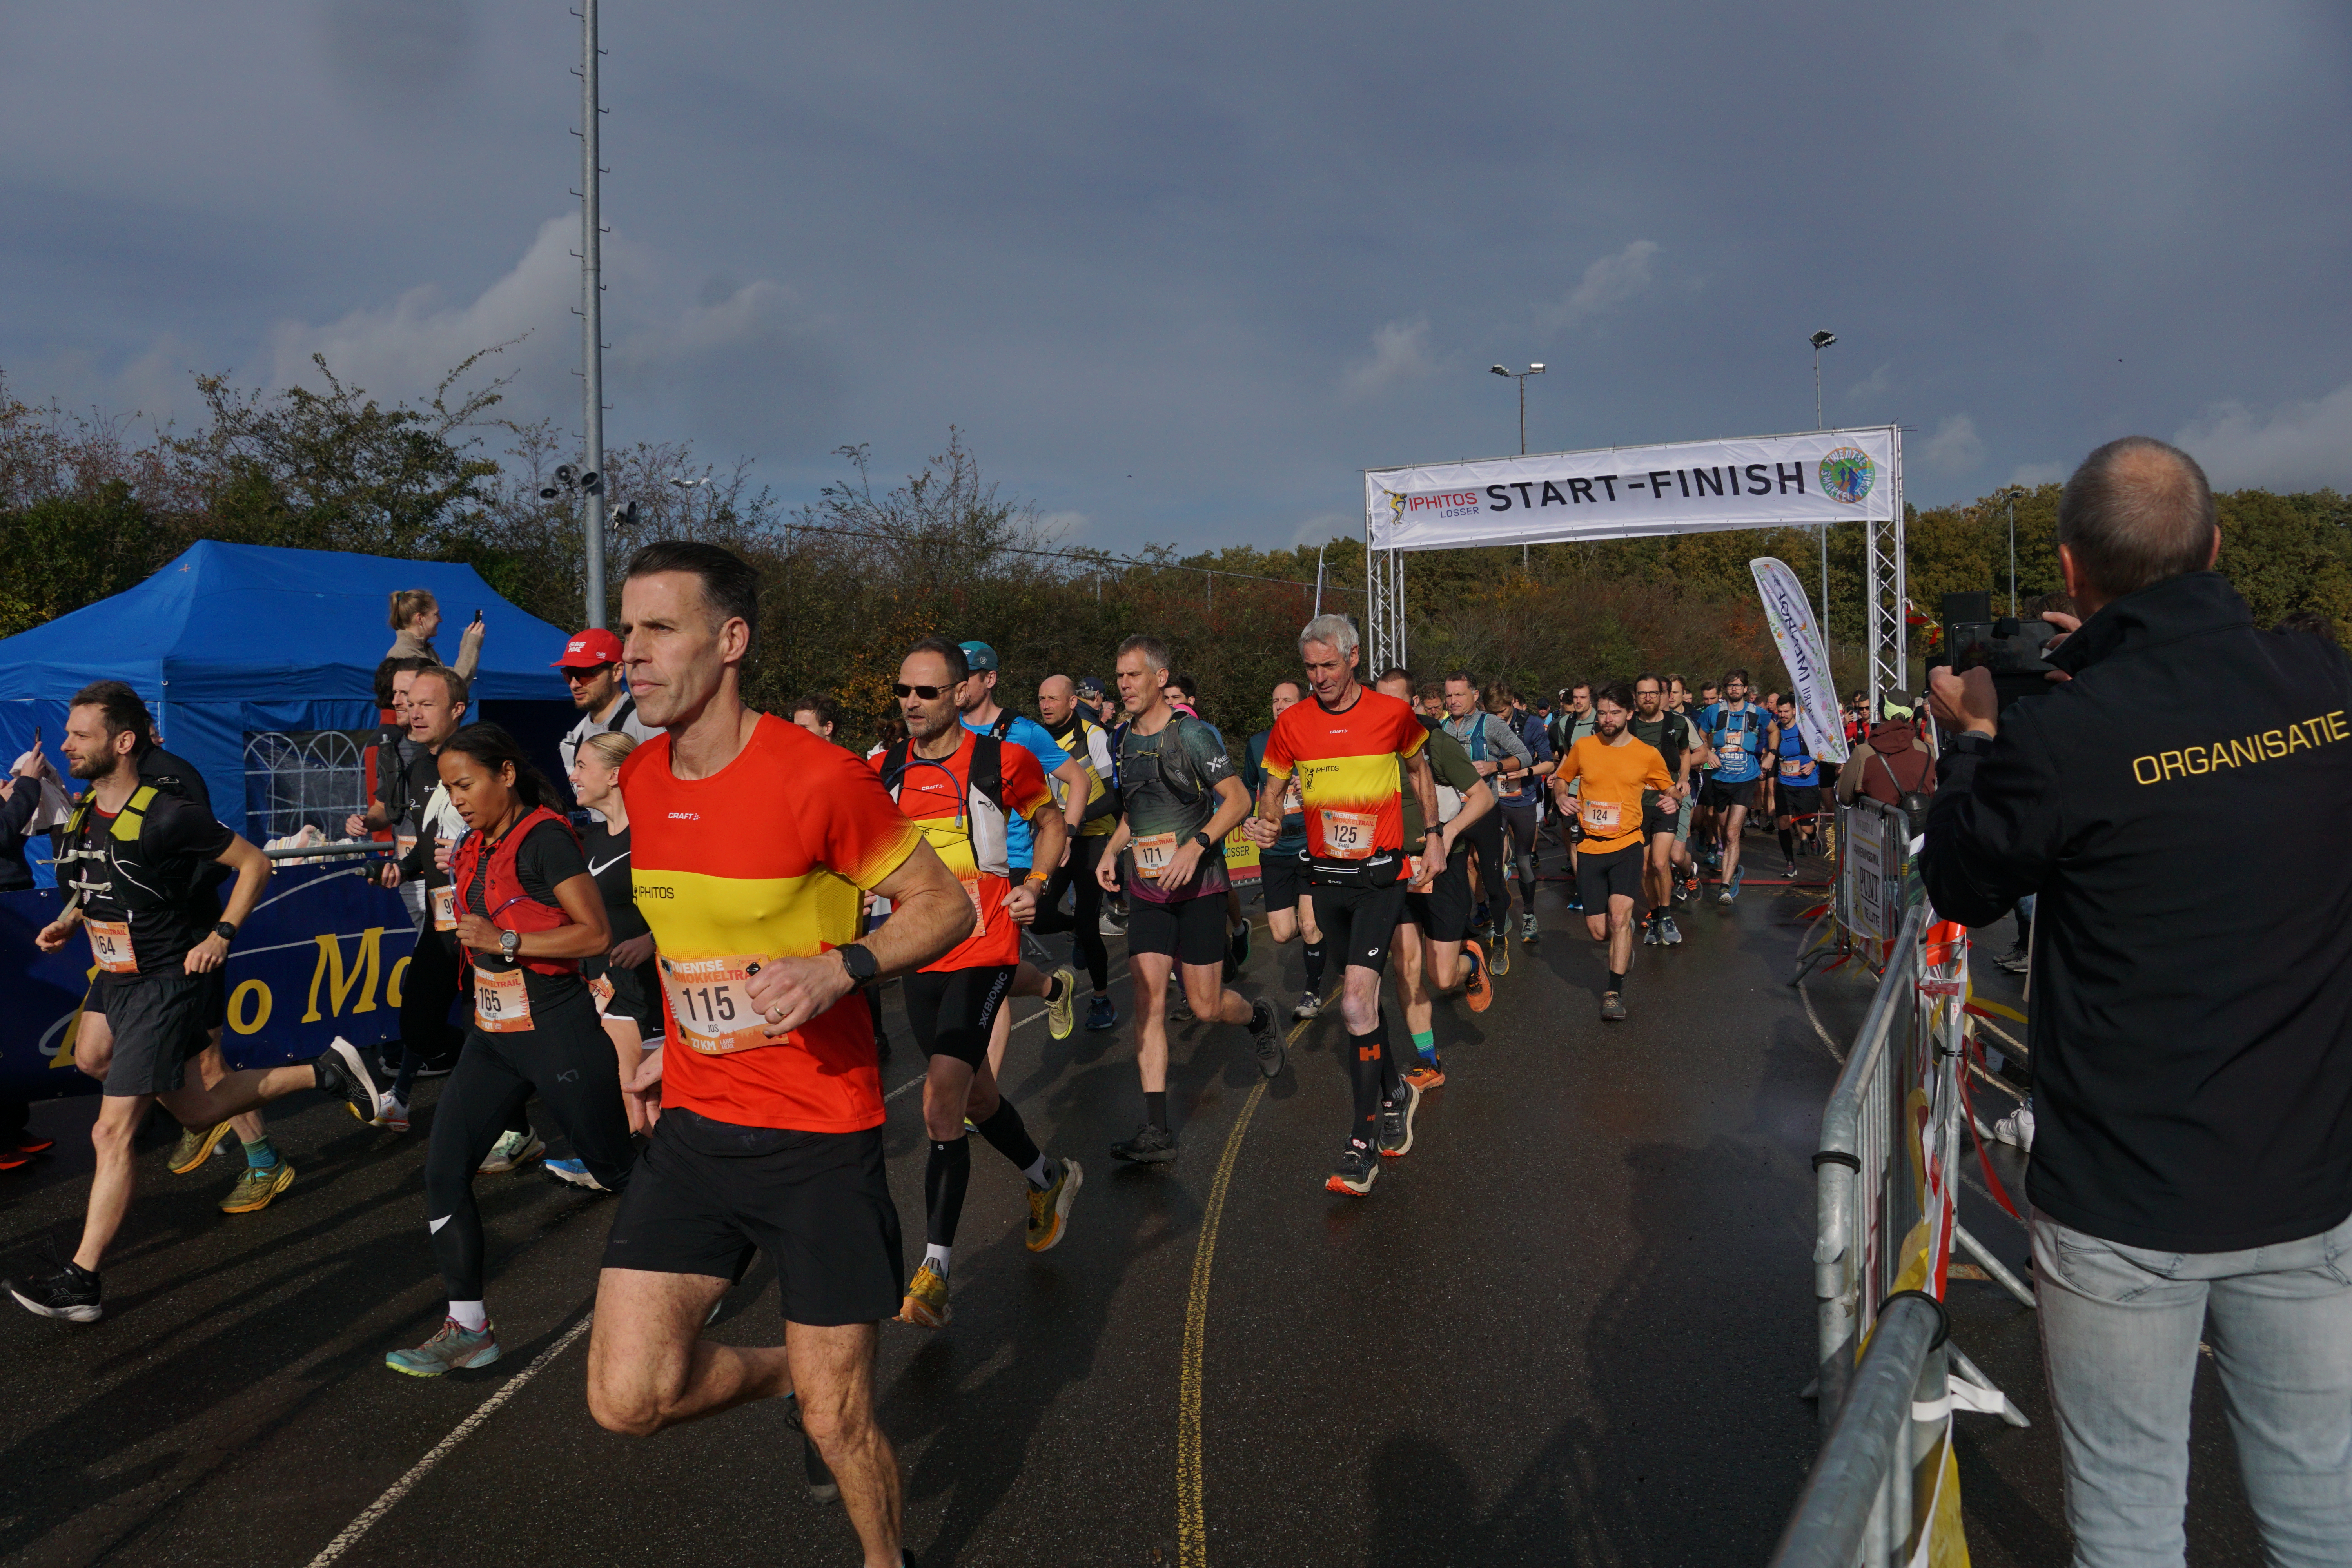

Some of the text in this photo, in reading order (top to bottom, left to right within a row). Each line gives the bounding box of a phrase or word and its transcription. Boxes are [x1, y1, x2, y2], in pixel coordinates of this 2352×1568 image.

[1824, 449, 1869, 466] TWENTSE
[1486, 461, 1805, 511] START-FINISH
[1821, 469, 1853, 502] SMOKKEL
[1855, 470, 1873, 497] TRAIL
[1409, 492, 1477, 512] IPHITOS
[1440, 507, 1479, 518] LOSSER
[2132, 710, 2350, 784] ORGANISATIE
[1315, 765, 1339, 773] IPHITOS
[1501, 781, 1509, 789] 52
[1332, 811, 1358, 820] TWENTSE
[1332, 816, 1374, 826] SMOKKELTRAIL
[1593, 809, 1608, 821] 124
[1334, 824, 1357, 843] 125
[1138, 838, 1174, 847] SMOKKELTRAIL
[1142, 847, 1162, 863] 171
[1859, 866, 1879, 903] PUNT
[639, 886, 674, 899] IPHITOS
[95, 935, 116, 955] 164
[670, 960, 724, 973] TWENTSE
[475, 968, 495, 981] TWENTSE
[673, 969, 752, 984] SMOKKELTRA
[479, 986, 501, 1012] 165
[682, 986, 735, 1021] 115
[708, 1024, 719, 1033] JOS
[691, 1037, 717, 1051] 27 KM
